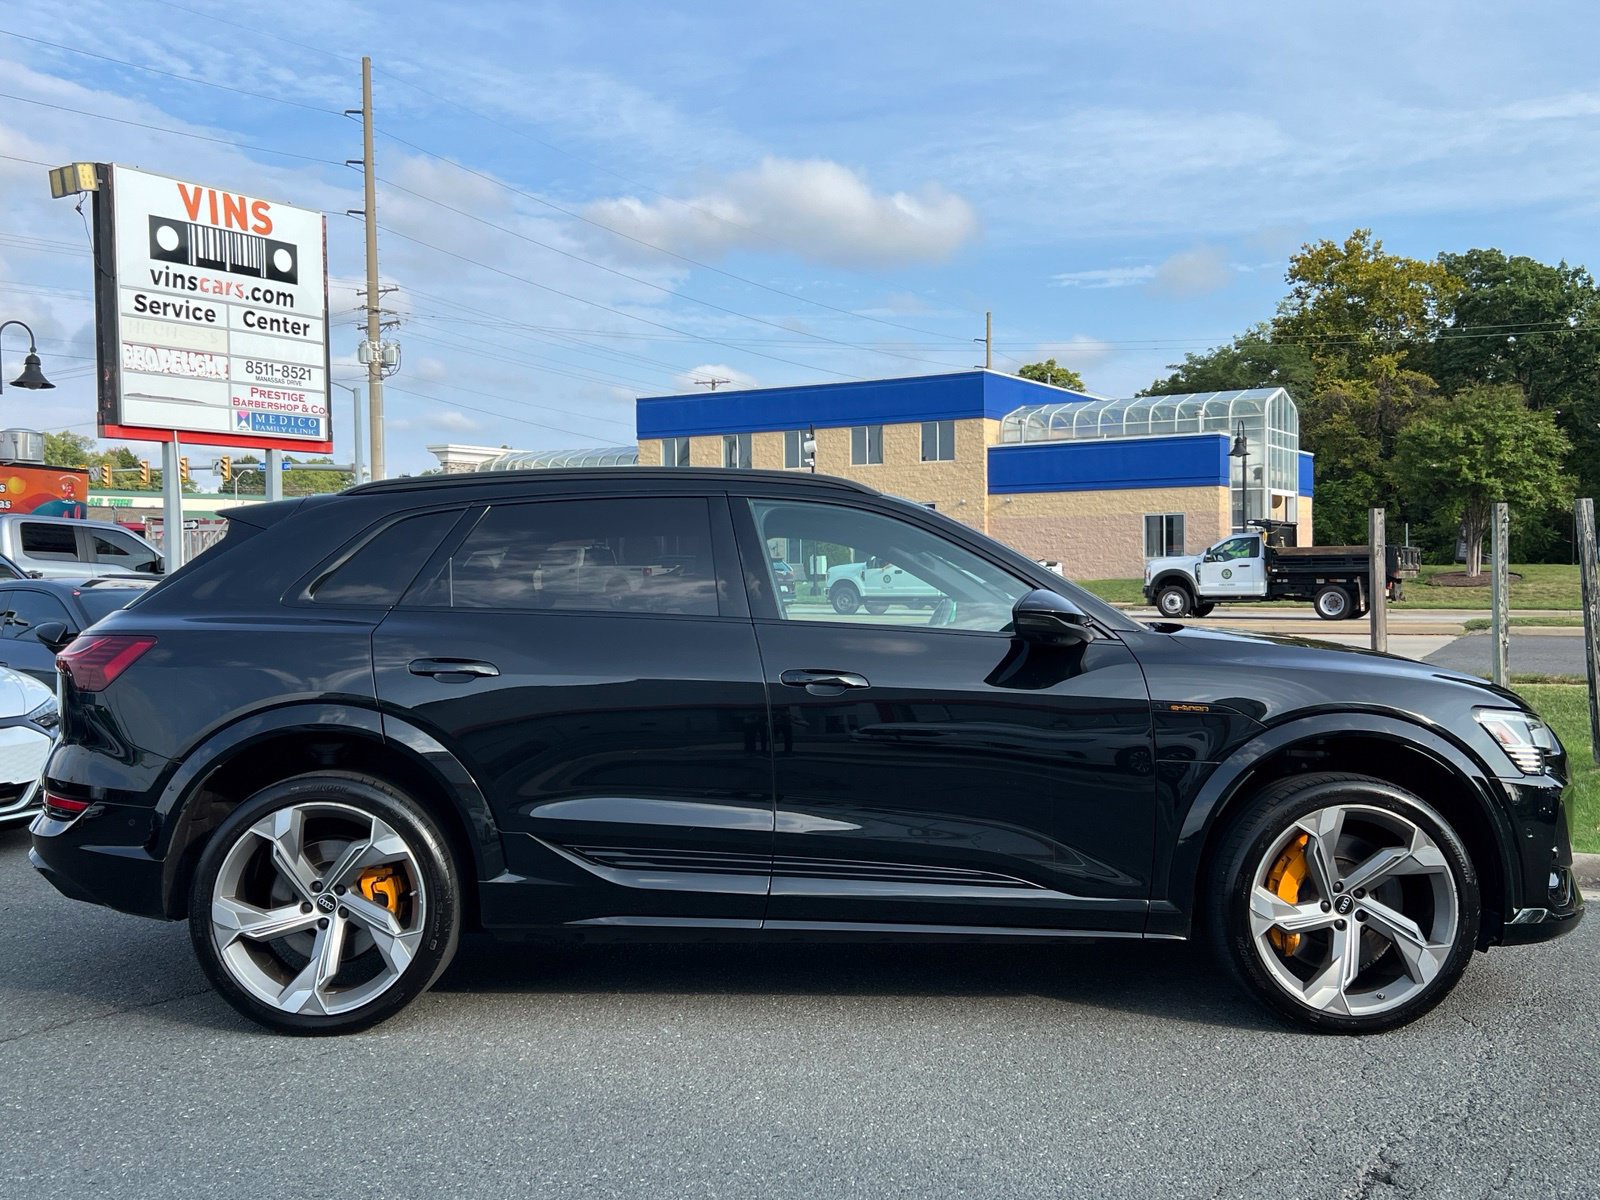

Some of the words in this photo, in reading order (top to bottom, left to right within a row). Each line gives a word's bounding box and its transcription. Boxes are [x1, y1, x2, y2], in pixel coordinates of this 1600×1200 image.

[176, 182, 273, 236] VINS
[149, 265, 295, 309] vinscars.com
[133, 293, 217, 323] Service
[242, 310, 311, 337] Center
[245, 360, 312, 381] 8511-8521
[255, 375, 286, 385] MANASSAS
[286, 379, 303, 387] DRIVE
[250, 387, 306, 403] PRESTIGE
[232, 396, 300, 412] BARBERSHOP
[301, 403, 309, 413] &
[255, 413, 317, 428] MEDICO
[255, 424, 287, 433] FAMILY
[288, 425, 318, 435] CLINIC
